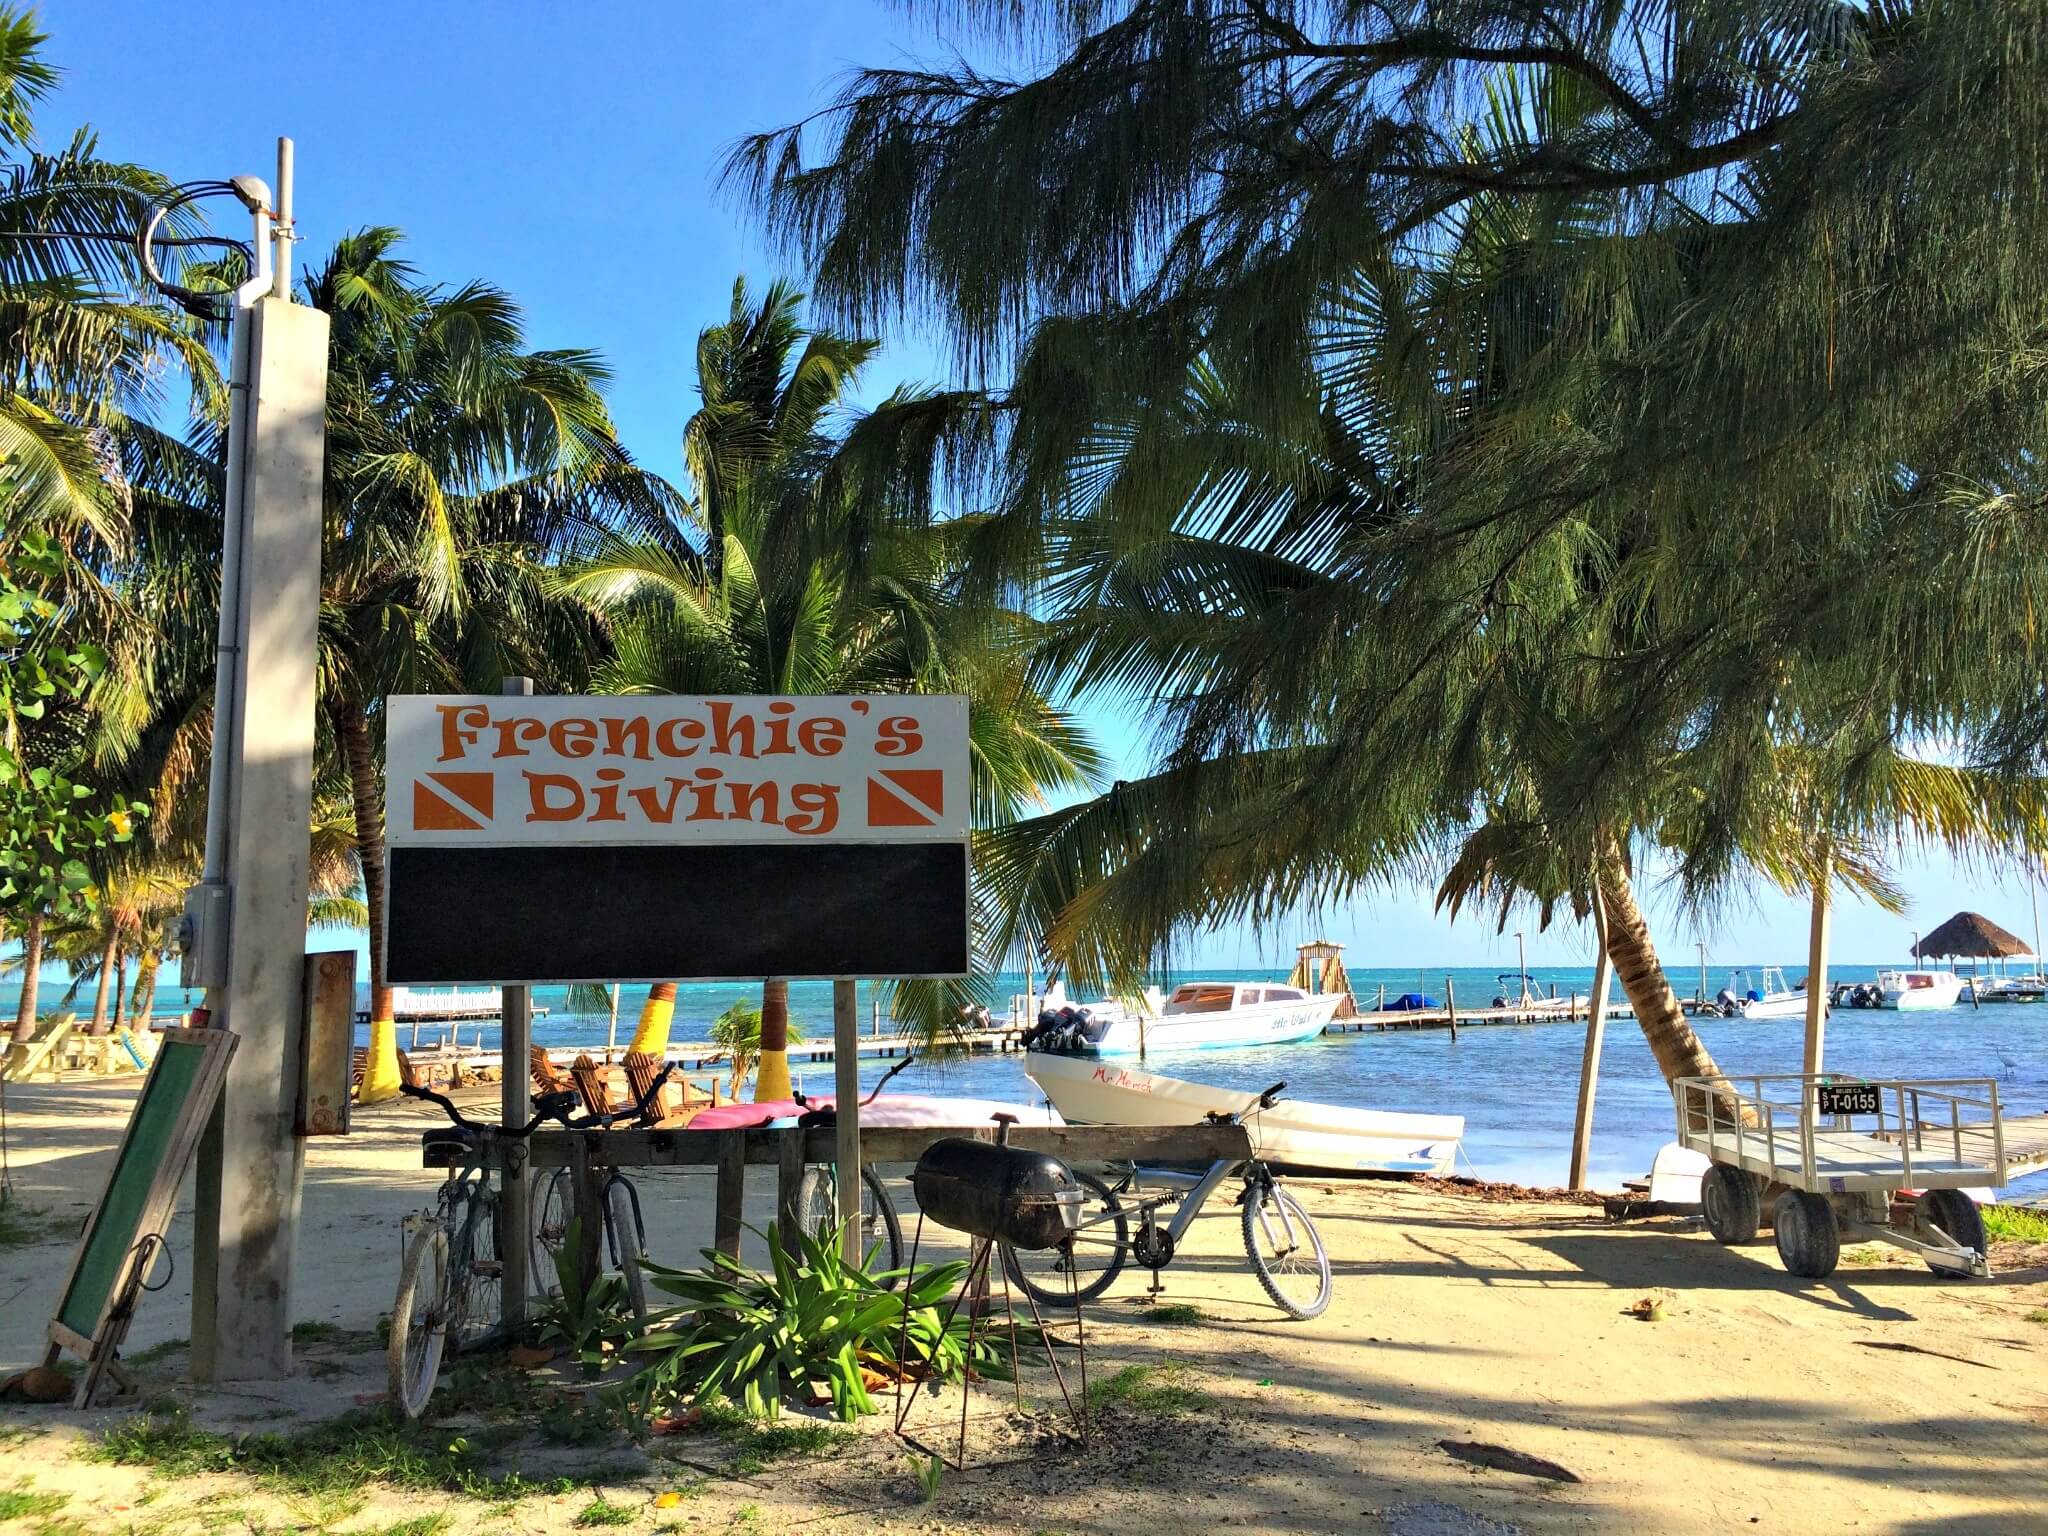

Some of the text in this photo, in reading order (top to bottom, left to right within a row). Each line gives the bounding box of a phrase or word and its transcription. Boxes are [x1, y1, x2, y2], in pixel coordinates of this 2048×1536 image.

[436, 701, 923, 762] Frenchie's
[521, 767, 841, 834] Diving
[1830, 1094, 1876, 1110] T-0155
